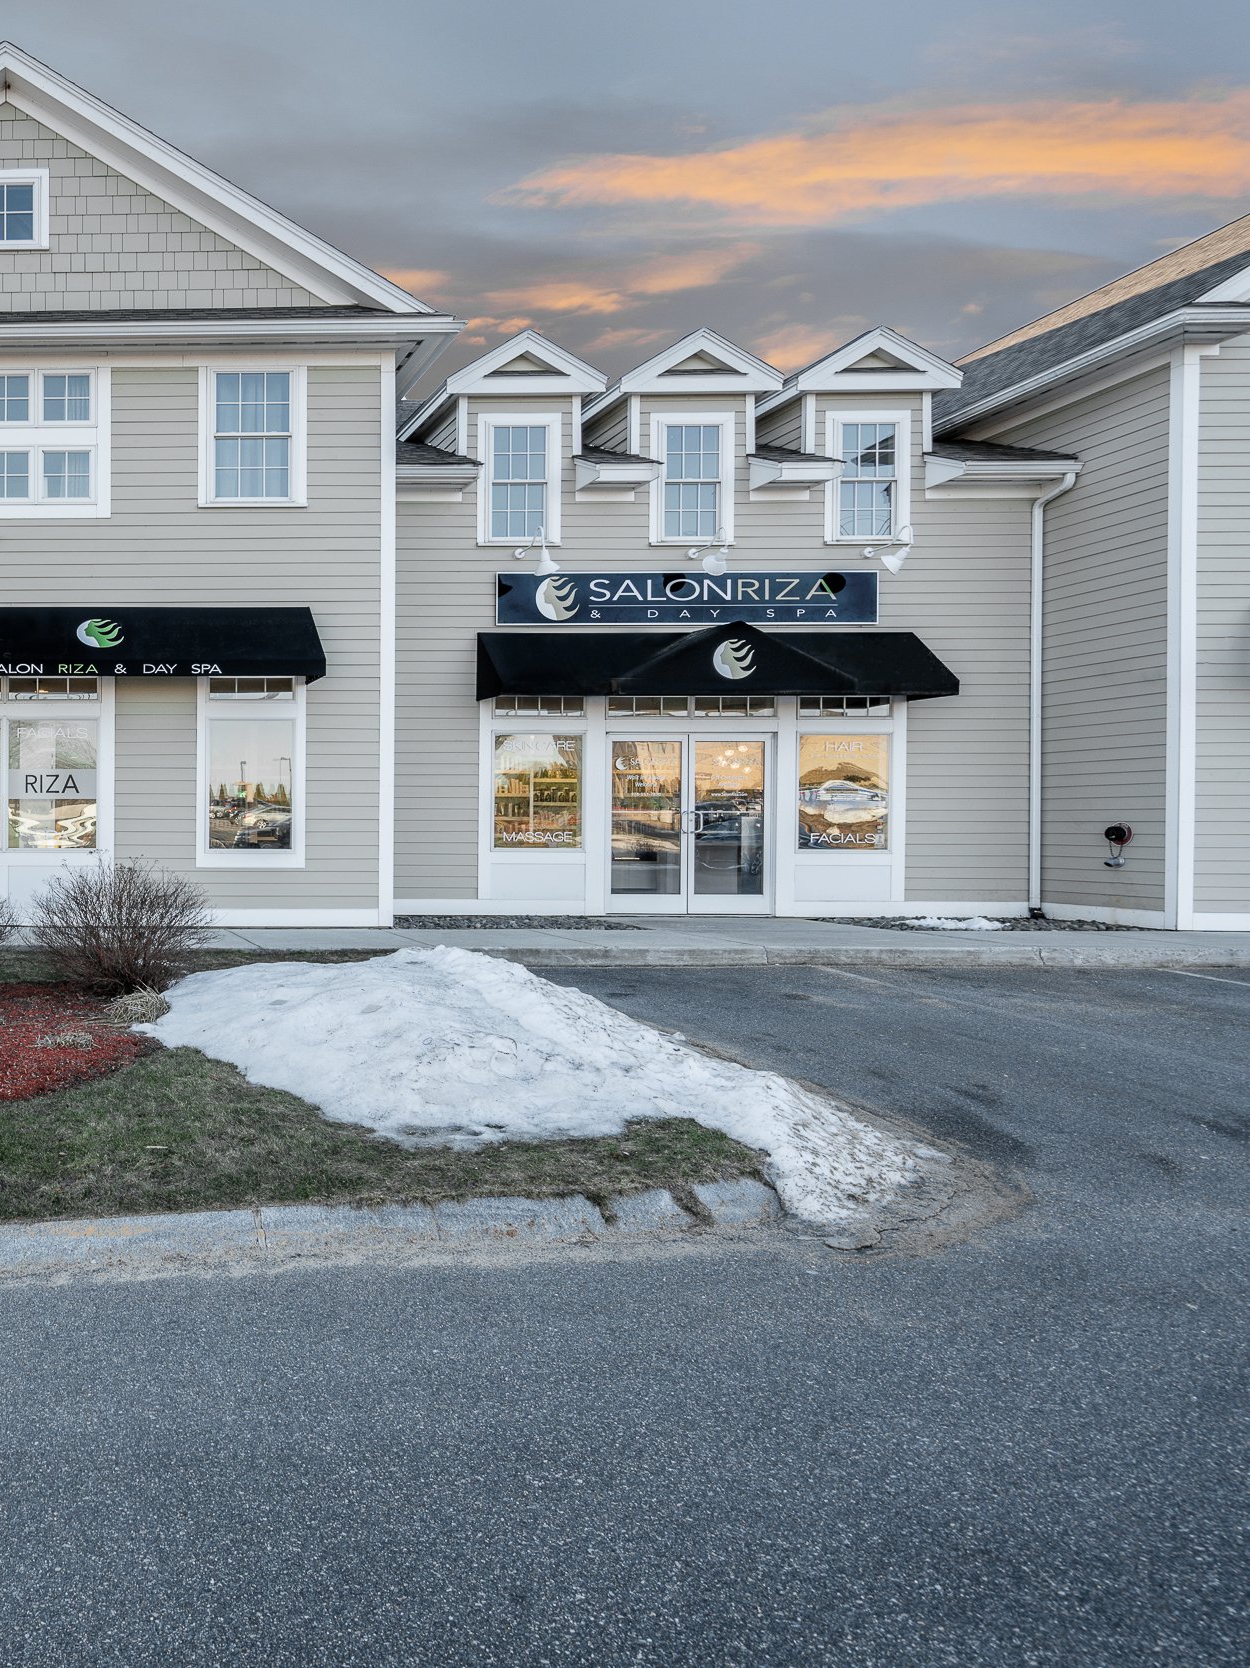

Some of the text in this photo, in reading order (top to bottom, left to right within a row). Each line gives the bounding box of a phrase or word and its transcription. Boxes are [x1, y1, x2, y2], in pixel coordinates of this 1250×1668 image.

[589, 609, 838, 619] & DAY SPA
[58, 663, 99, 674] RIZA
[114, 663, 127, 674] &
[143, 663, 178, 674] DAY
[191, 663, 222, 674] SPA
[16, 727, 88, 739] FACIALS
[825, 741, 863, 752] HAIR
[25, 774, 80, 794] RIZA
[503, 831, 573, 842] MASSAGE
[810, 832, 876, 844] FACIALS
